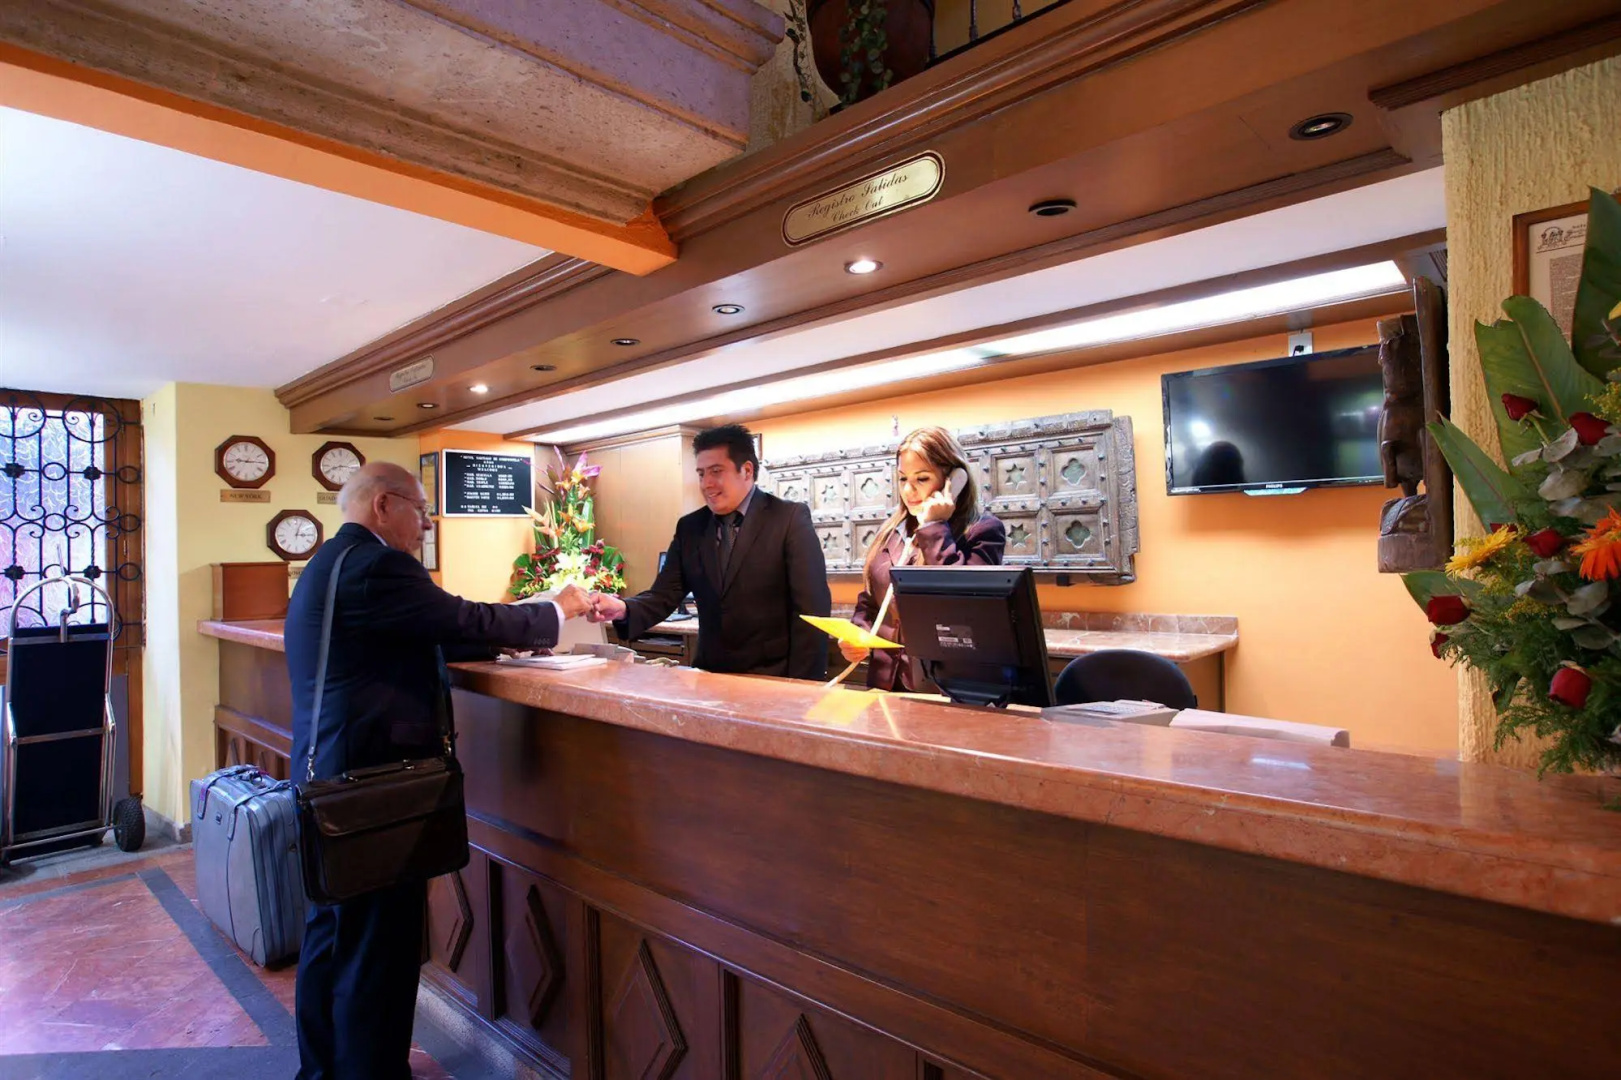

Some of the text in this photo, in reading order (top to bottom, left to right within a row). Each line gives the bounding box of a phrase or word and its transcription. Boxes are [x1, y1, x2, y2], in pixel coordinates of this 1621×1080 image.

[808, 173, 909, 218] Registro Salidas
[831, 207, 860, 222] Check
